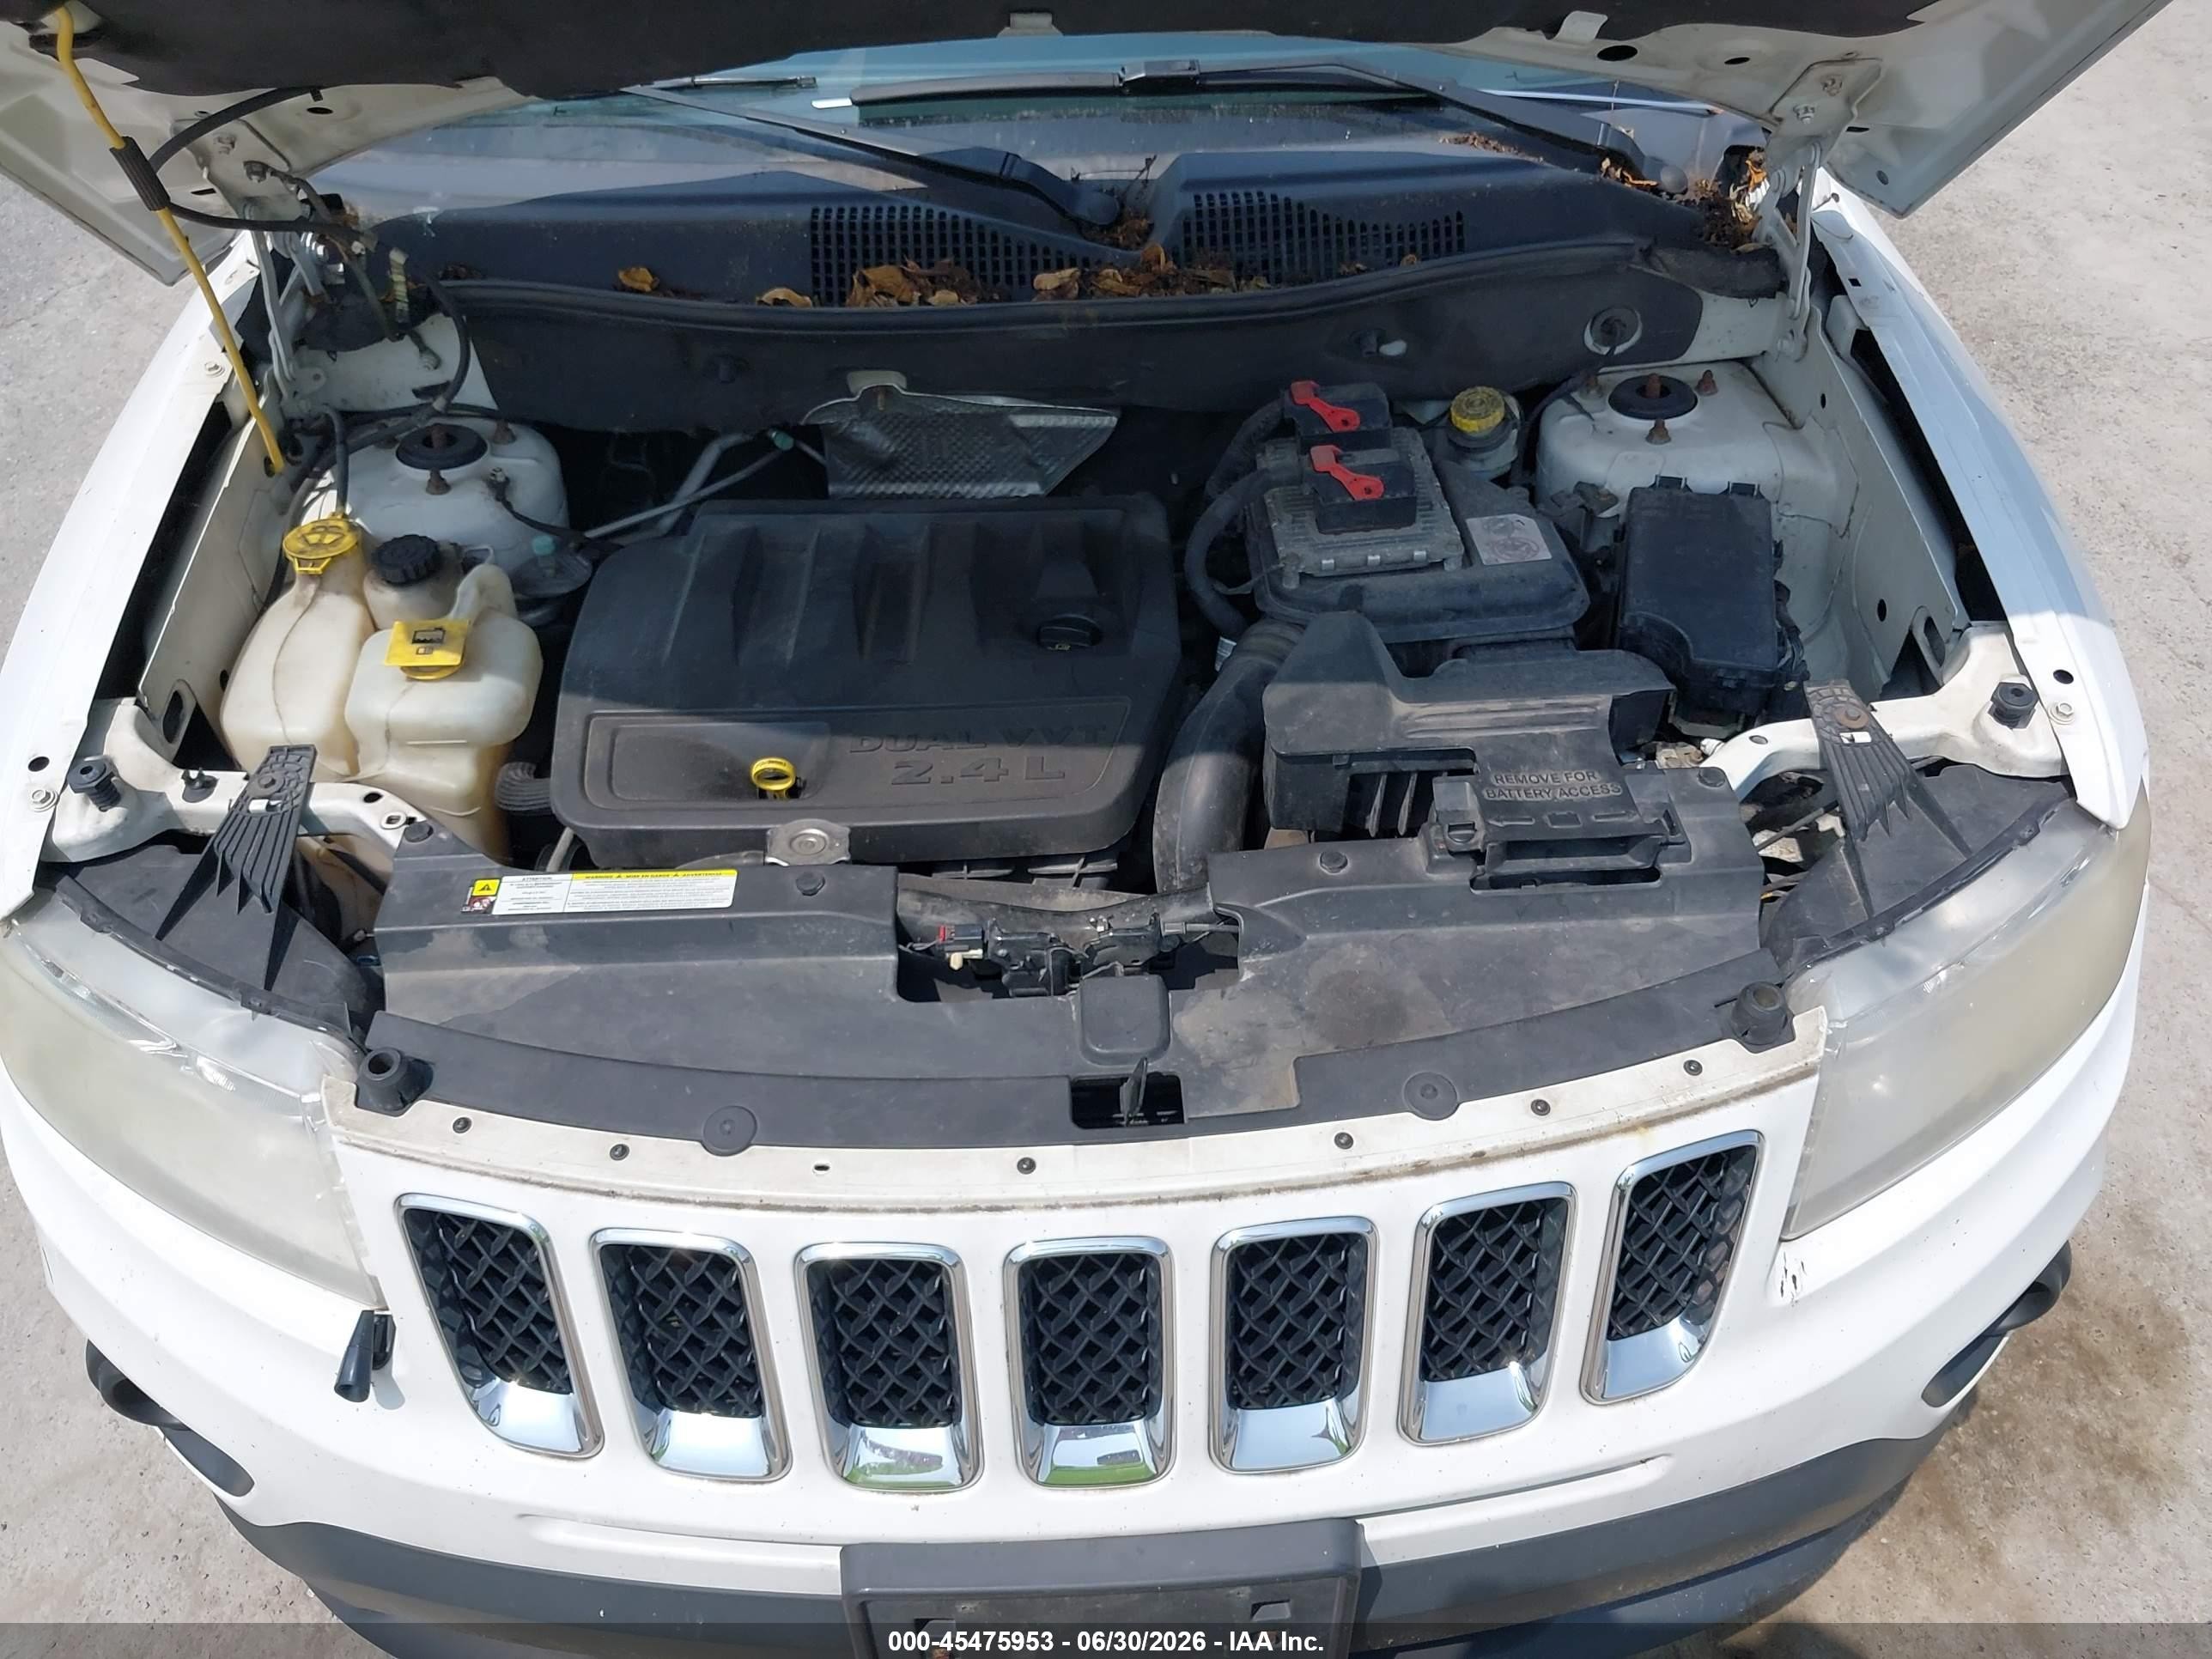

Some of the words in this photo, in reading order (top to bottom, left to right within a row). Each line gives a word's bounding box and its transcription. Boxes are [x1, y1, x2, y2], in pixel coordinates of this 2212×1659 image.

[849, 729, 988, 753] DUAL
[999, 723, 1108, 750] VVT
[1494, 773, 1561, 785] REMOVE
[1563, 770, 1597, 783] FOR
[1485, 787, 1553, 799] BATTERY
[1558, 783, 1622, 799] ACCESS
